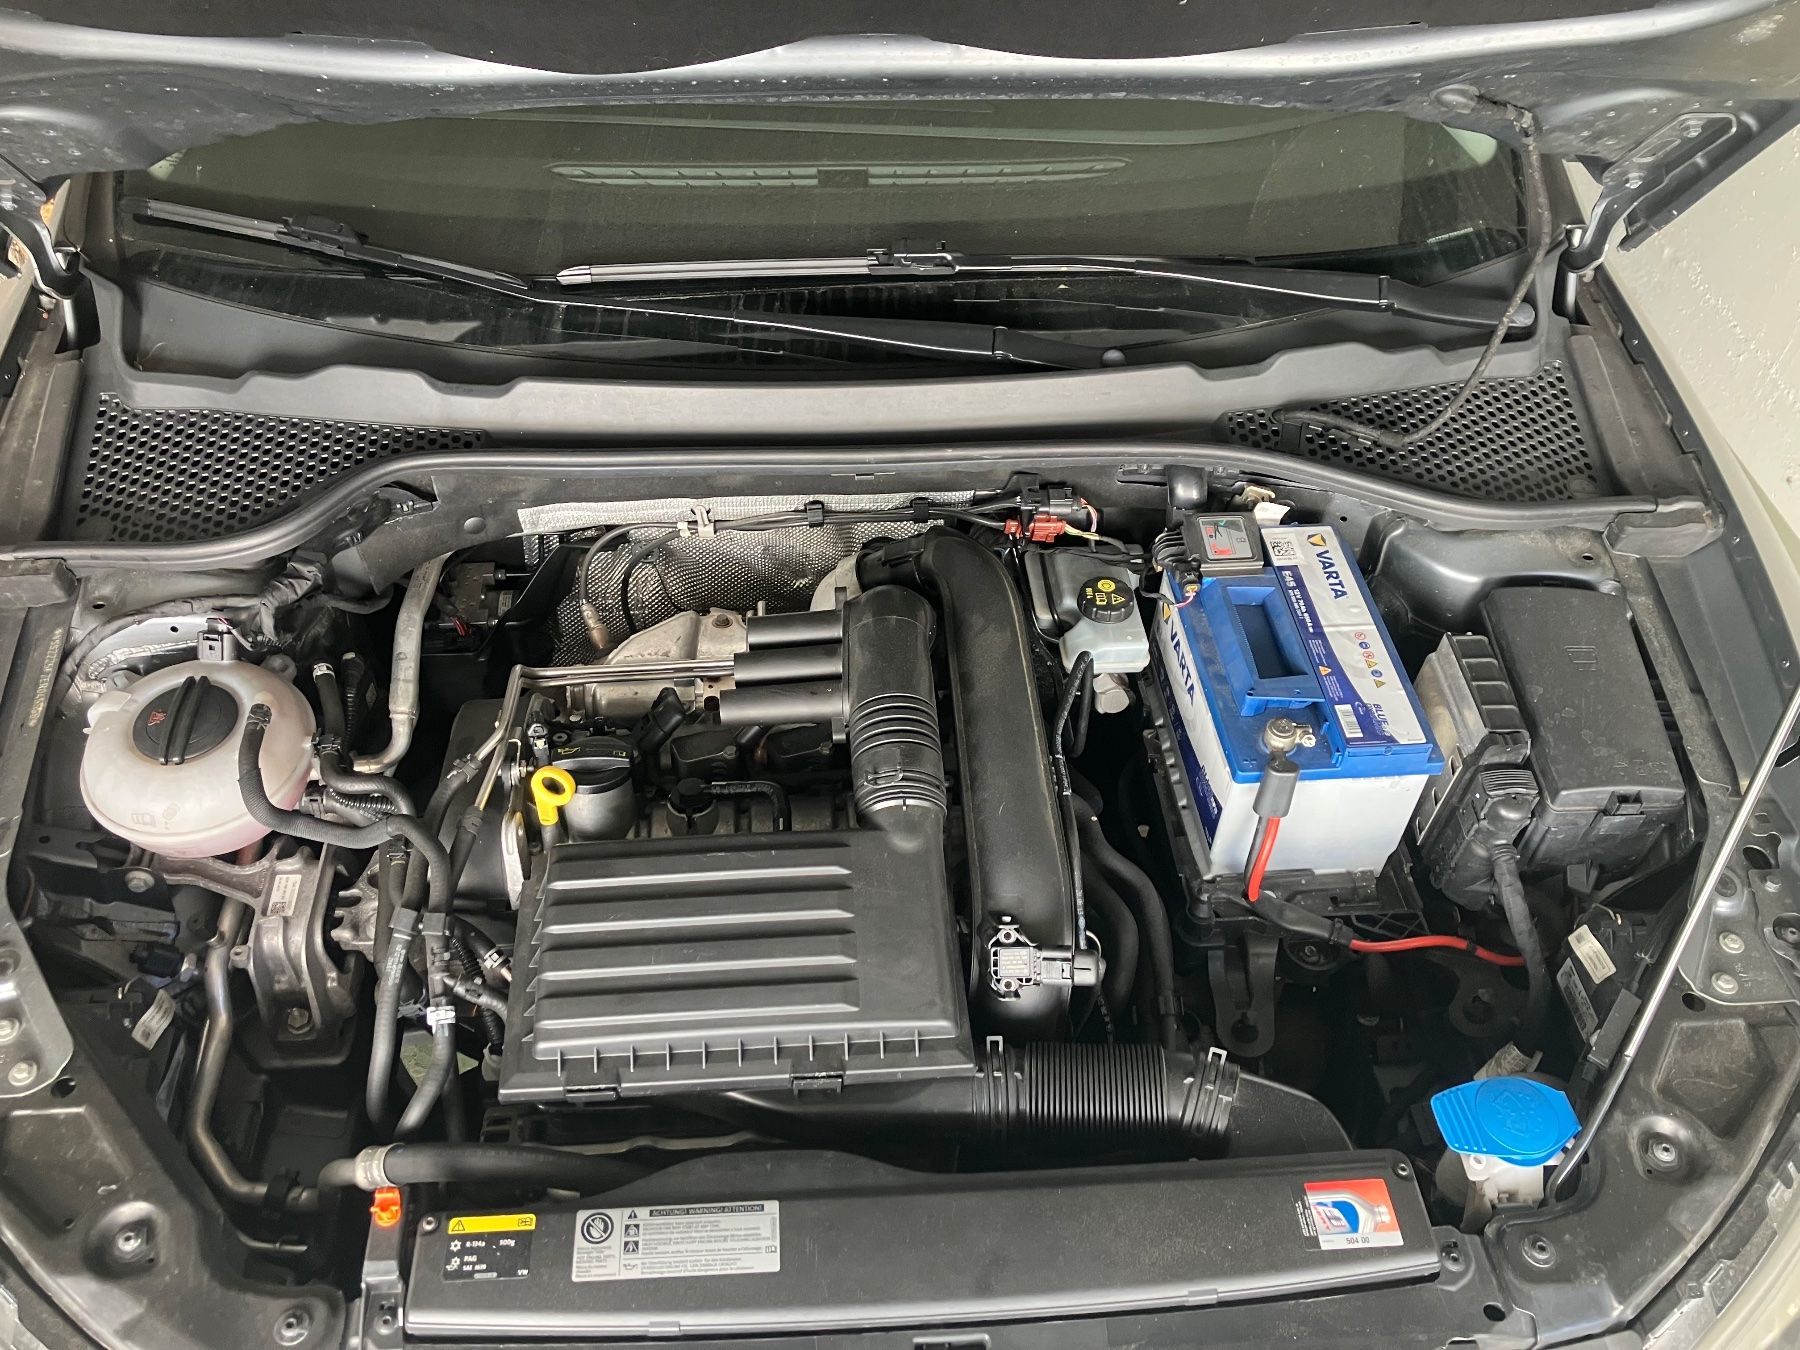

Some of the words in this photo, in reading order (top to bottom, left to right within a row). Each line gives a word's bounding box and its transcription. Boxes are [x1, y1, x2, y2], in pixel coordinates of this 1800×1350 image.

[1316, 549, 1349, 600] VARTA
[1170, 619, 1195, 707] VARTA
[688, 1206, 722, 1215] WARNING!
